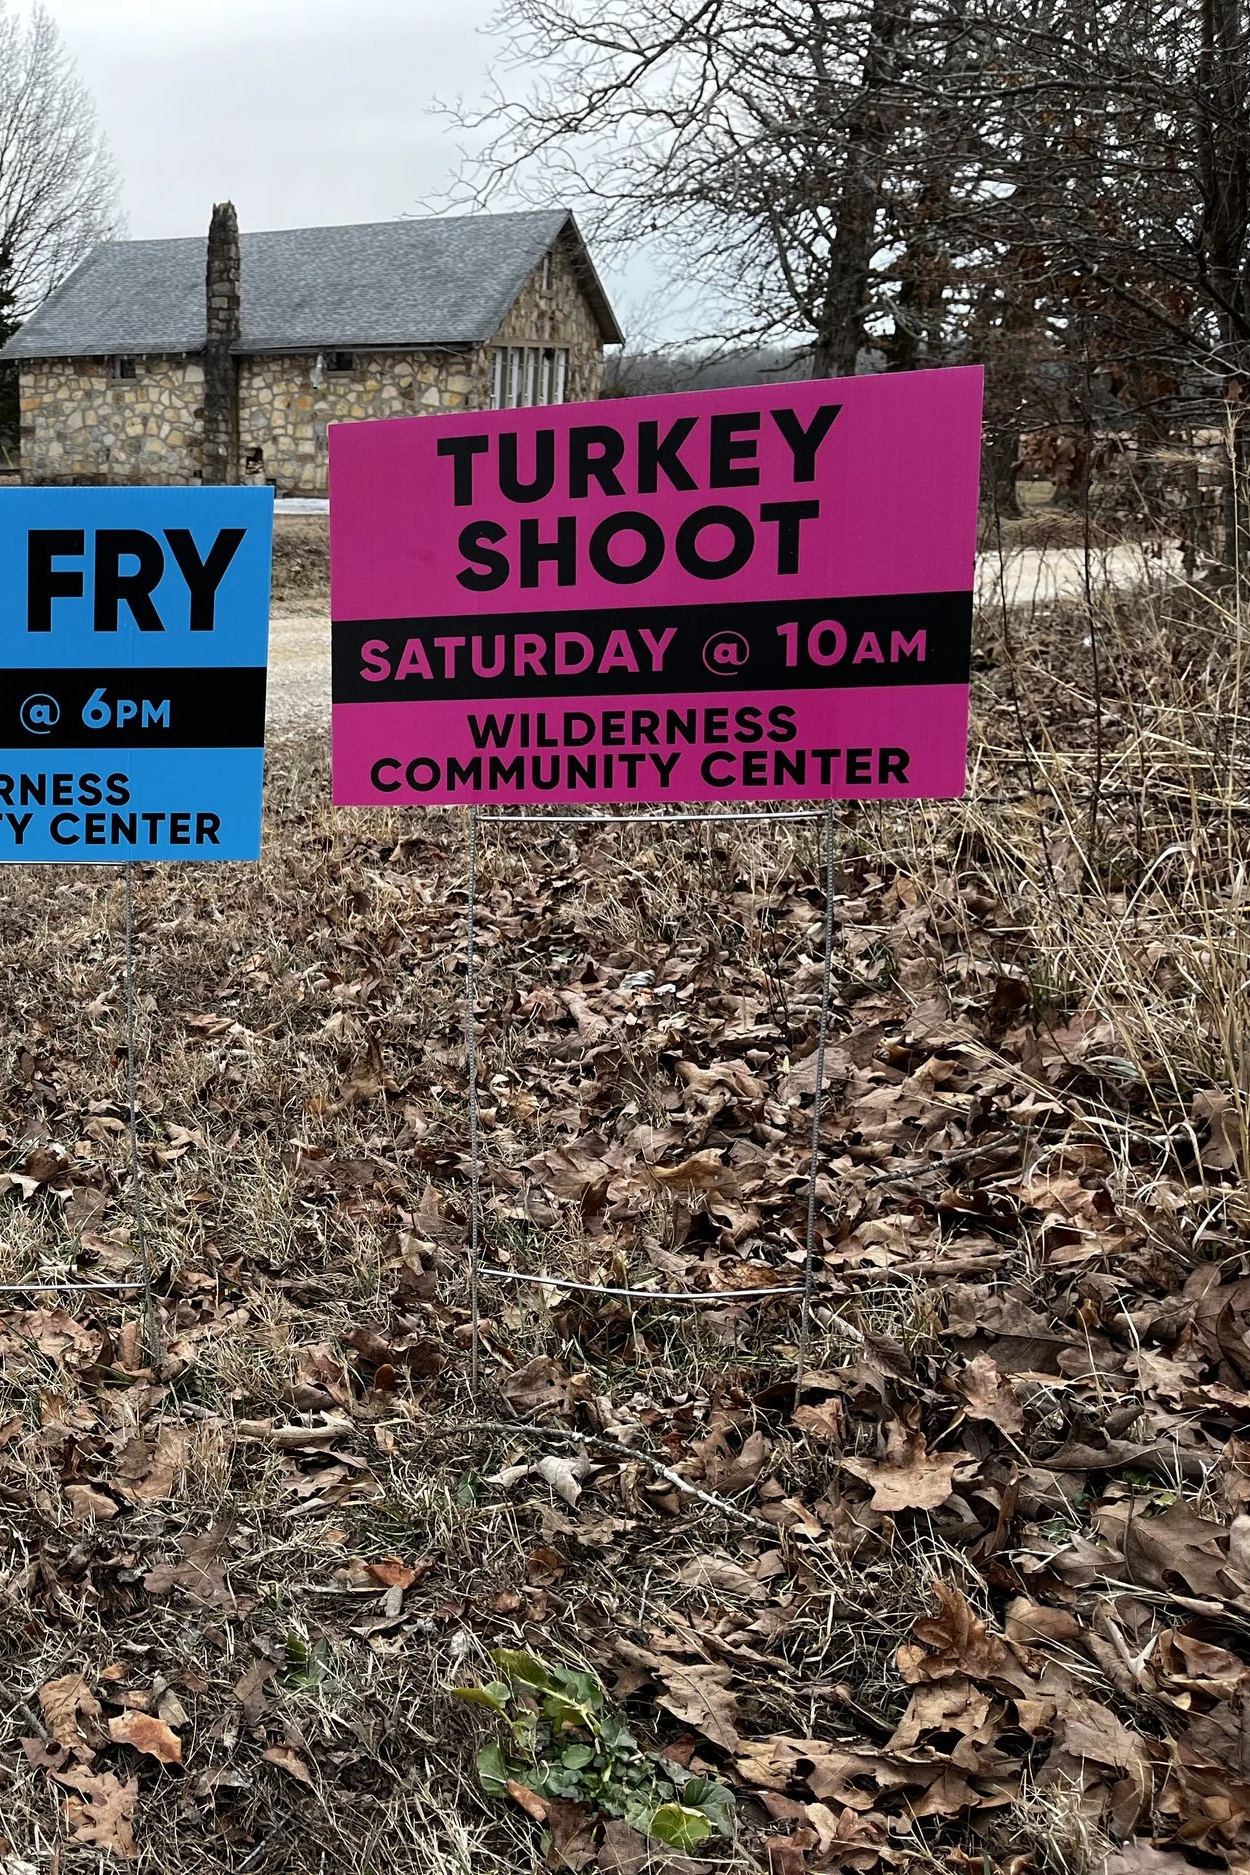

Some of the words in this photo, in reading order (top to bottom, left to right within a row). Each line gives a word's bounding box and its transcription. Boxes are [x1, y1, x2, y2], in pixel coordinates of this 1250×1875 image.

[437, 404, 844, 506] TURKEY
[455, 499, 819, 592] SHOOT
[27, 528, 248, 632] FRY
[359, 627, 678, 682] SATURDAY
[702, 631, 749, 675] @
[776, 619, 927, 667] 10AM
[19, 693, 60, 734] @
[81, 688, 171, 729] 6PM
[467, 705, 798, 749] WILDERNESS
[370, 752, 681, 793] COMMUNITY
[700, 747, 910, 788] CENTER
[50, 811, 221, 845] CENTER
